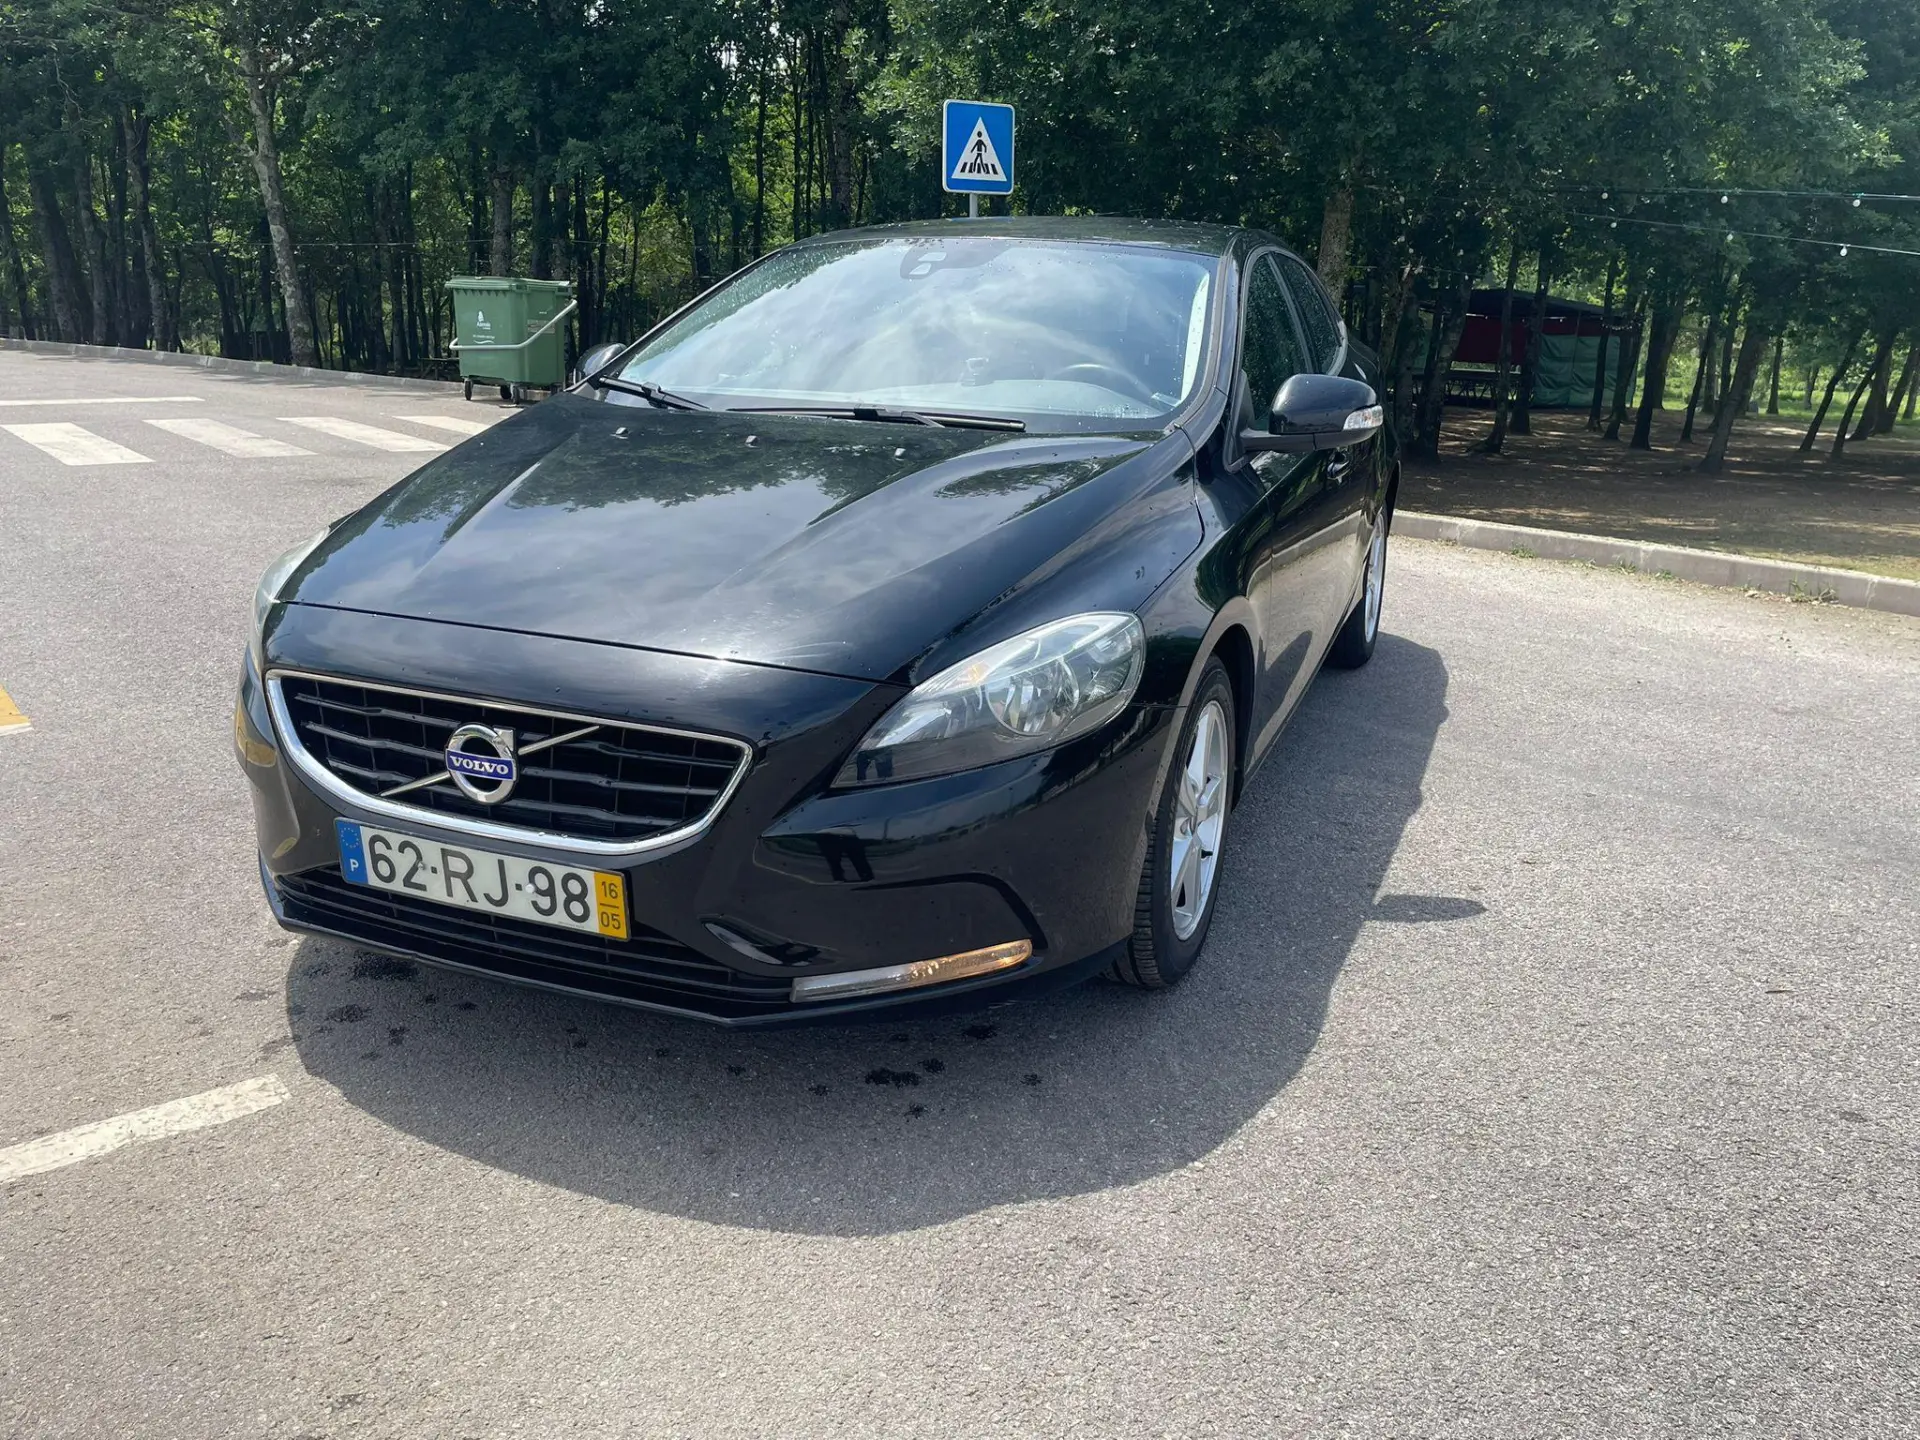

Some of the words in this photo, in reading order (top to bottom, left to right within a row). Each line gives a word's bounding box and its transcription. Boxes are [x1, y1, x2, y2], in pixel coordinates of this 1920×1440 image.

[450, 755, 510, 775] VOLVO
[349, 858, 359, 872] P
[601, 881, 619, 900] 16
[600, 913, 621, 931] 05
